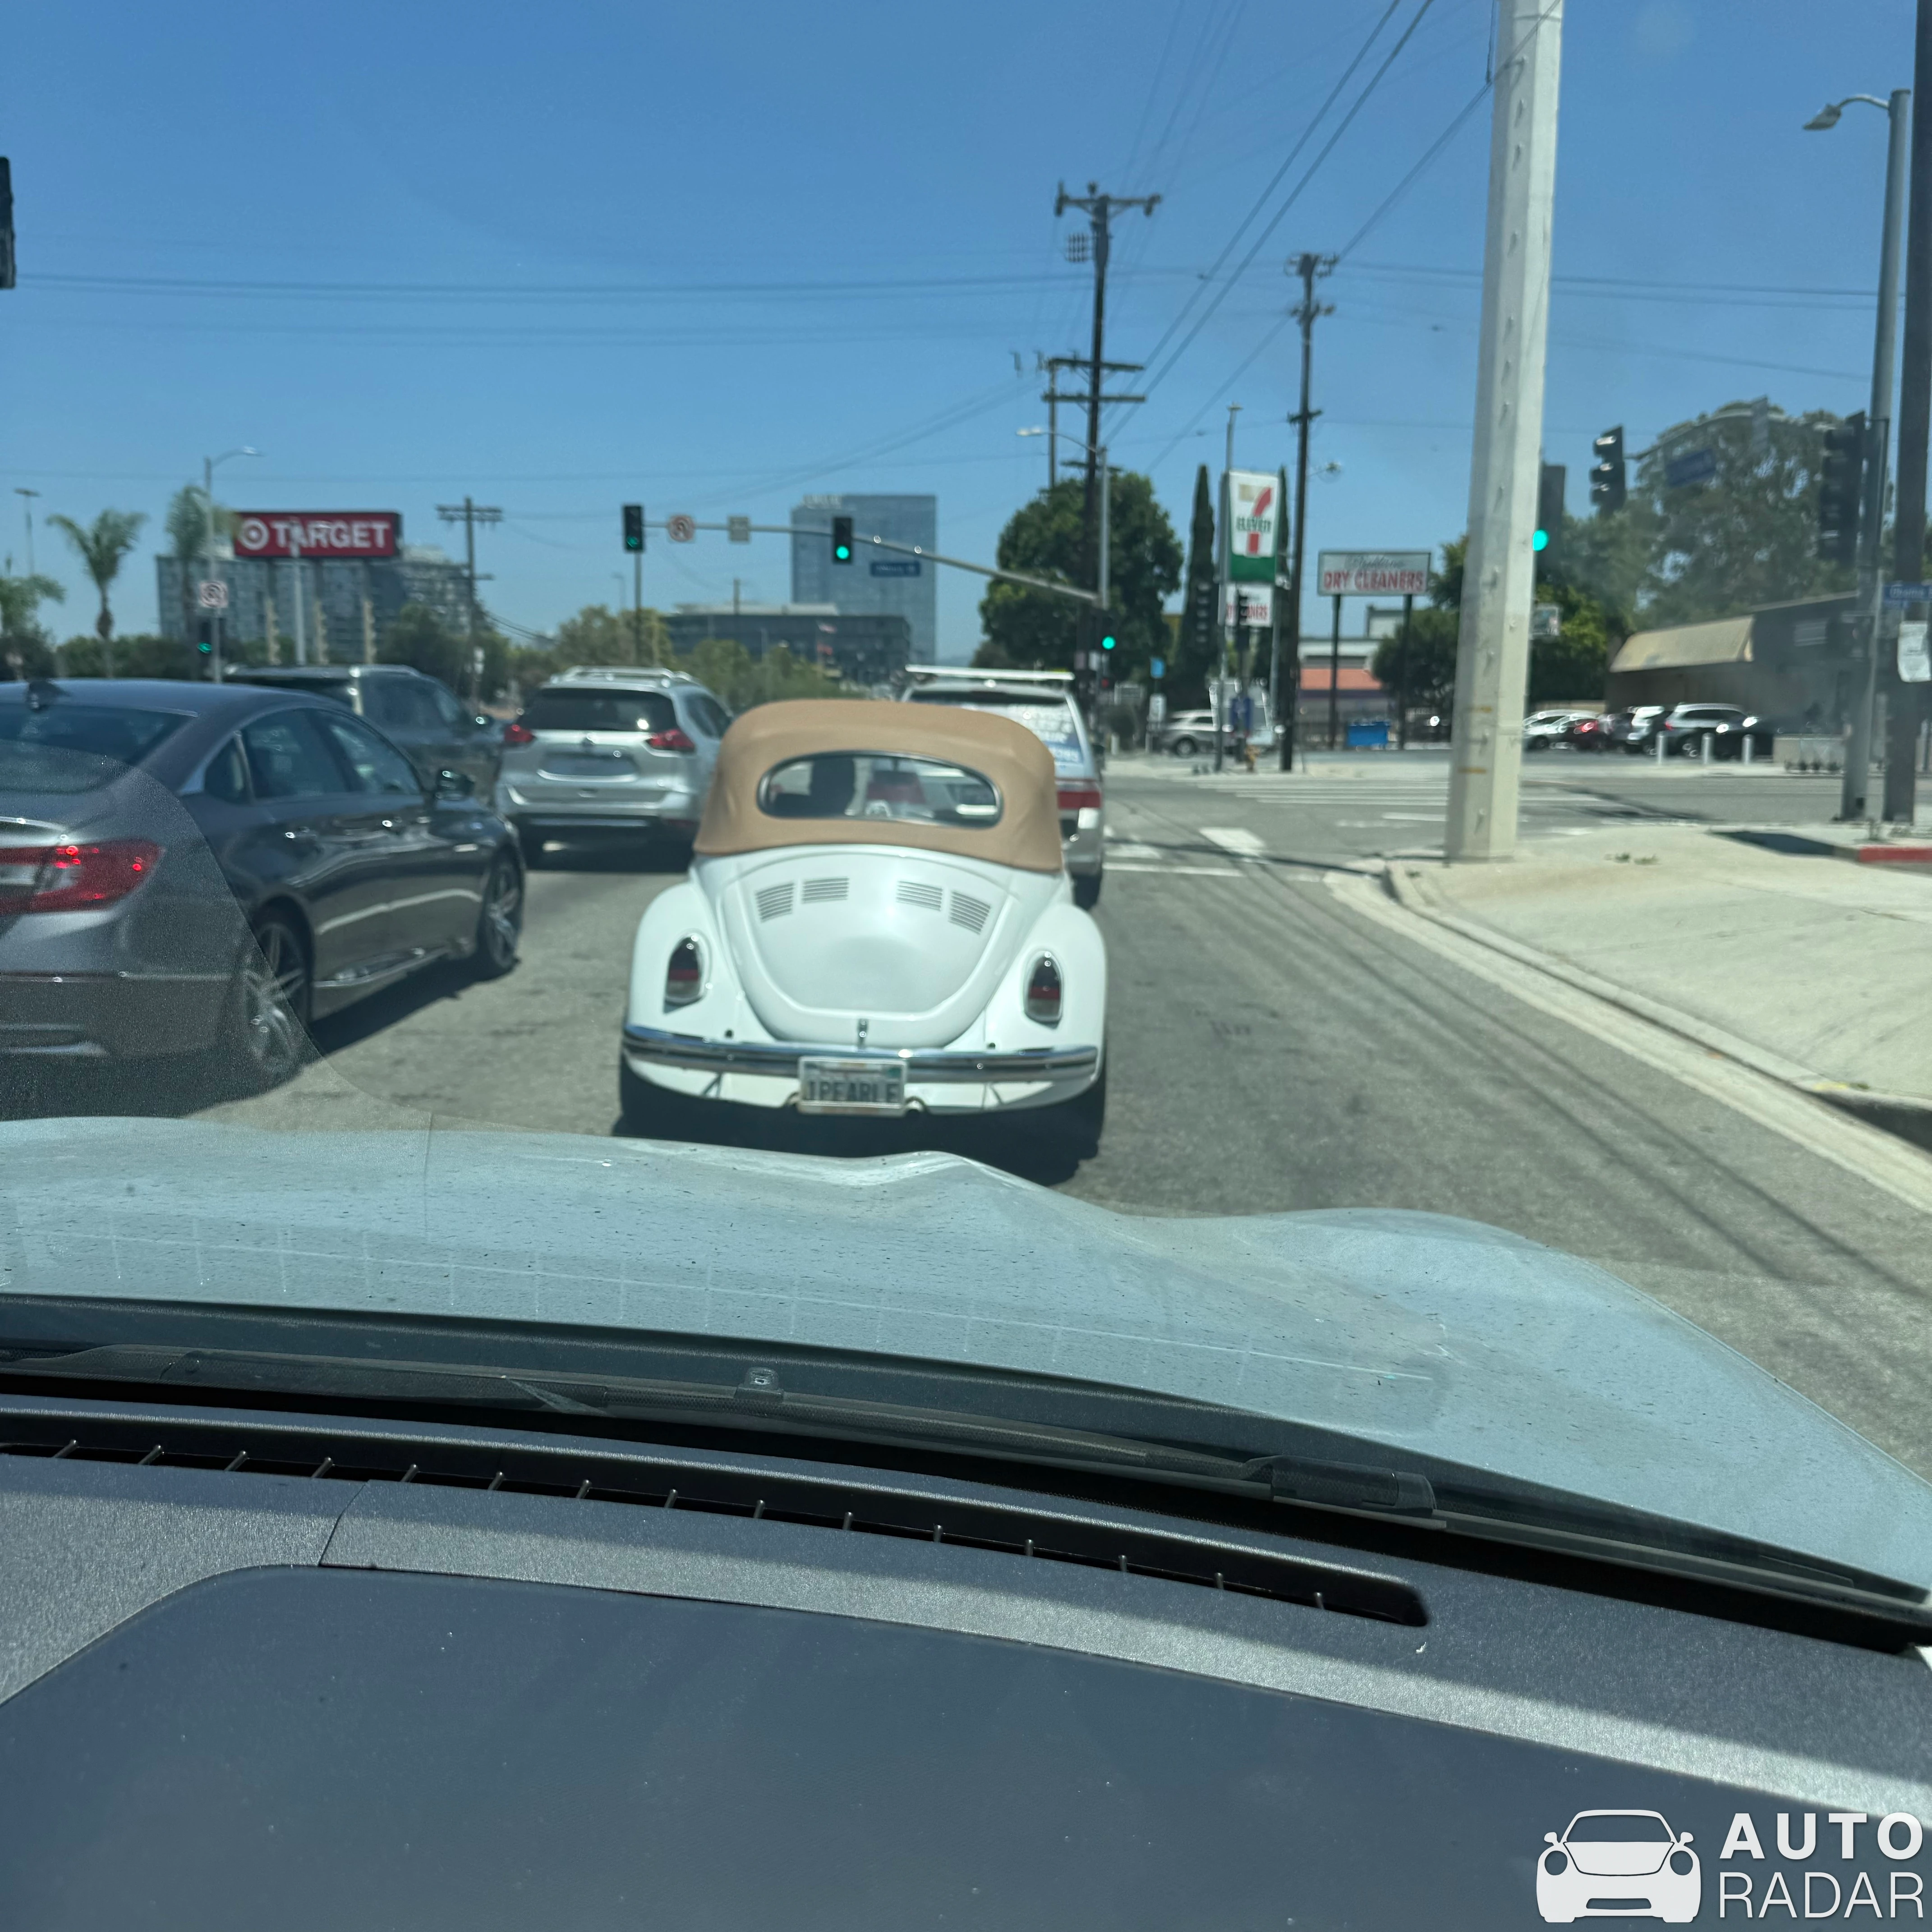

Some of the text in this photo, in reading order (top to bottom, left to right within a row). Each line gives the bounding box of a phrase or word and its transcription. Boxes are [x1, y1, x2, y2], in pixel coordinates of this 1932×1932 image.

[270, 519, 391, 548] TARGET
[1324, 570, 1424, 592] DRY CLEANERS
